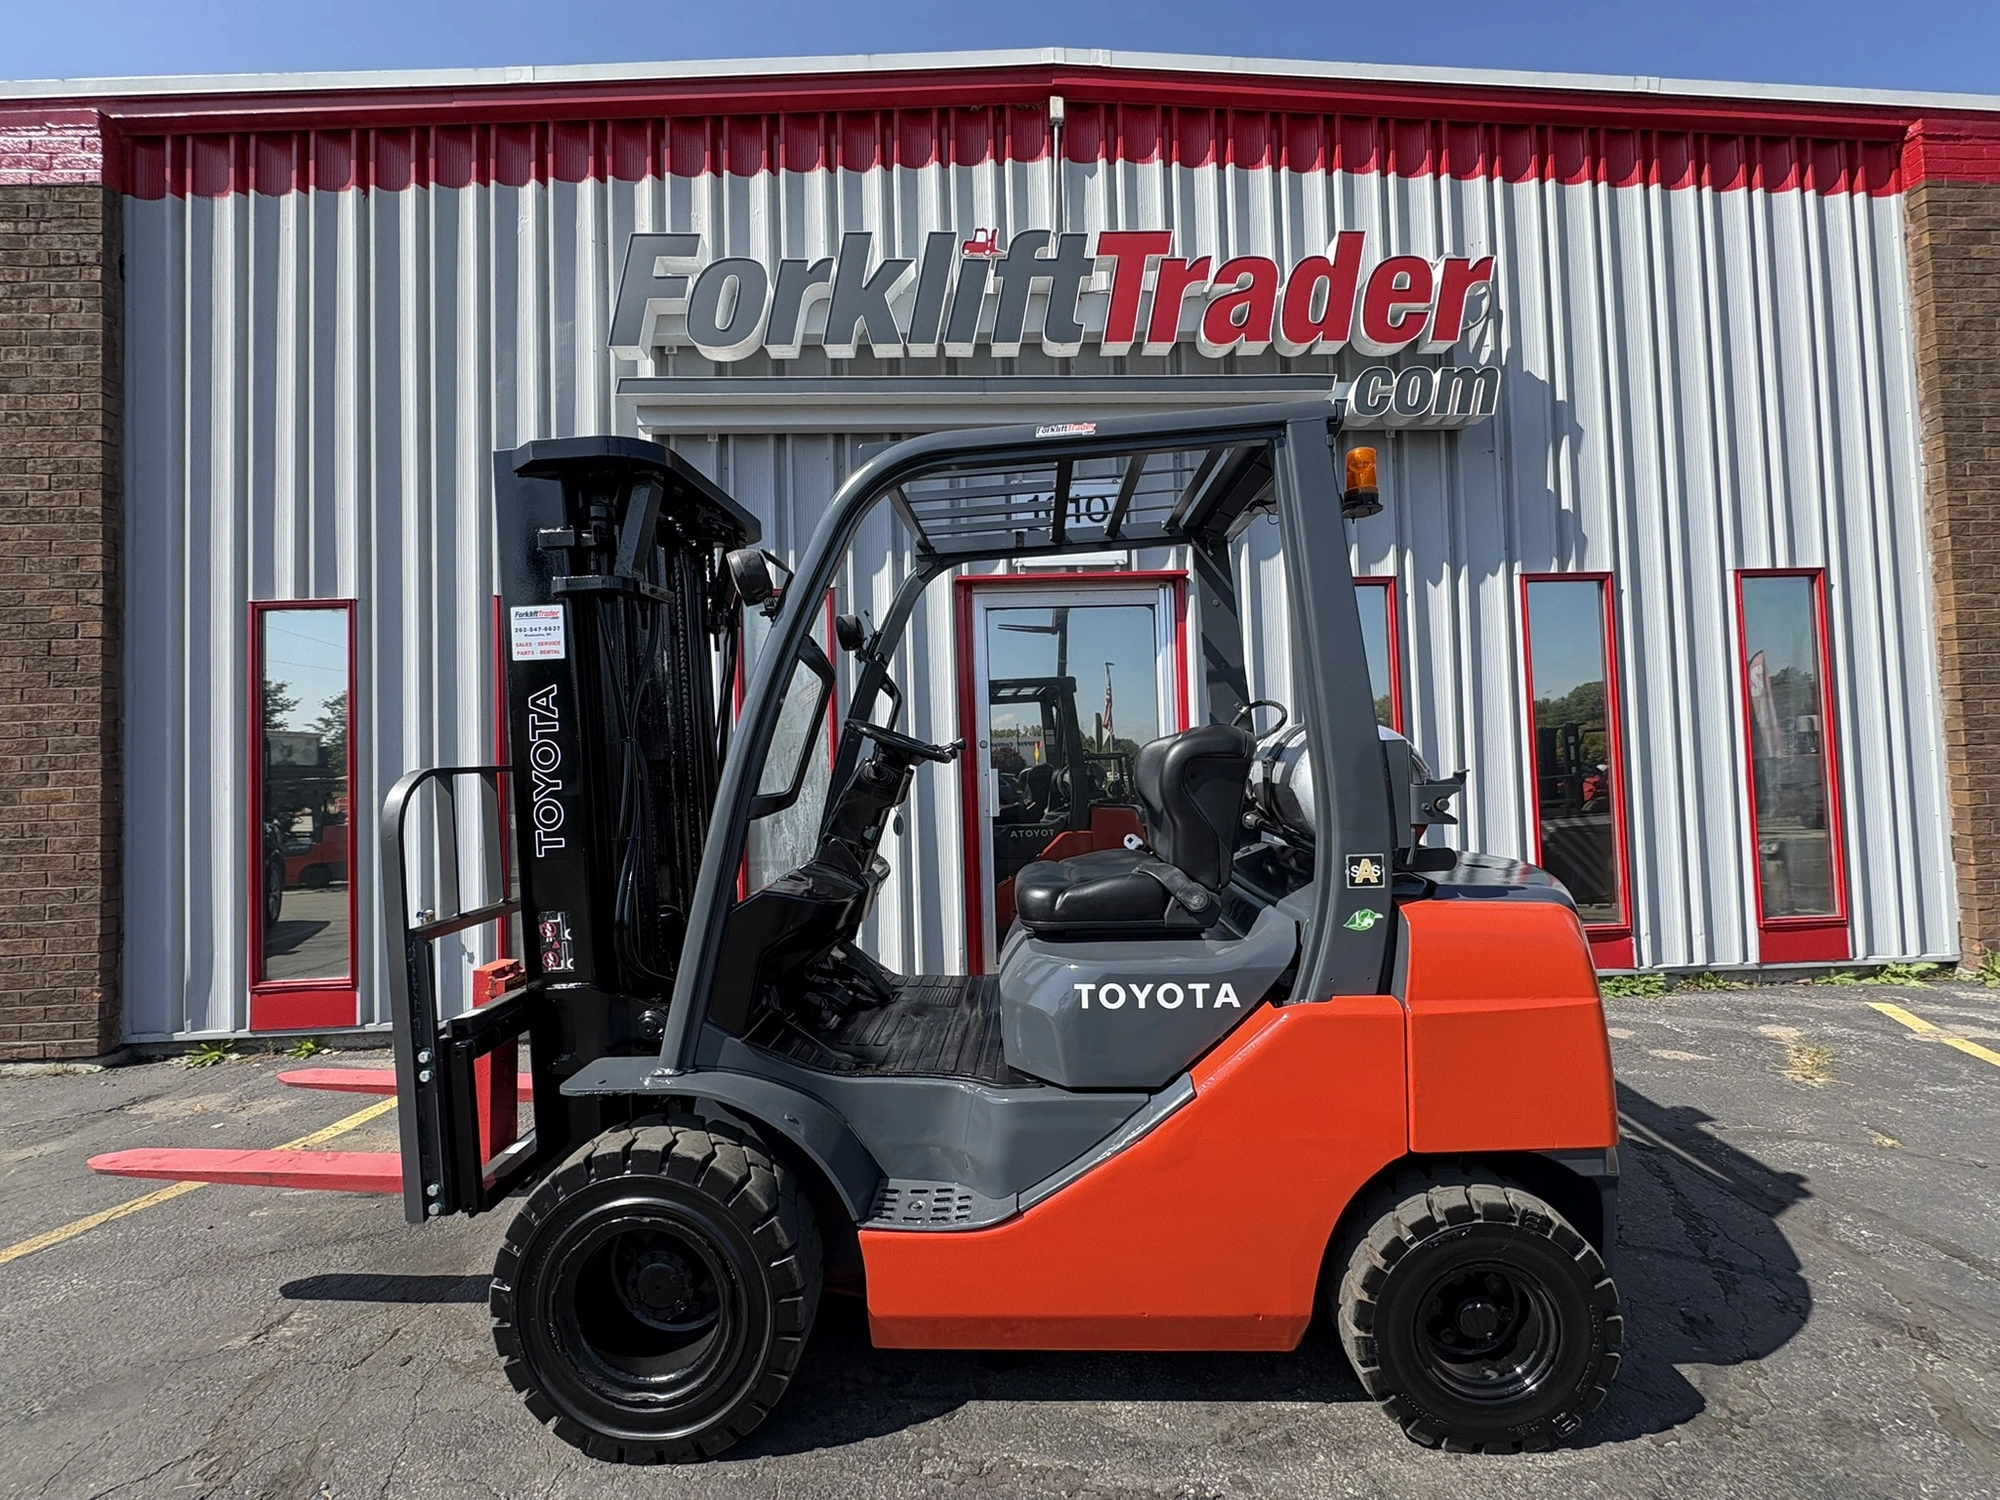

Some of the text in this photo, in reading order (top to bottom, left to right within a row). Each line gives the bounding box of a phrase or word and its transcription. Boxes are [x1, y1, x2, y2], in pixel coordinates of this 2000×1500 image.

[607, 227, 1496, 349] ForkliftTrader
[528, 683, 565, 858] TOYOTA
[1073, 982, 1242, 1010] TOYOTA
